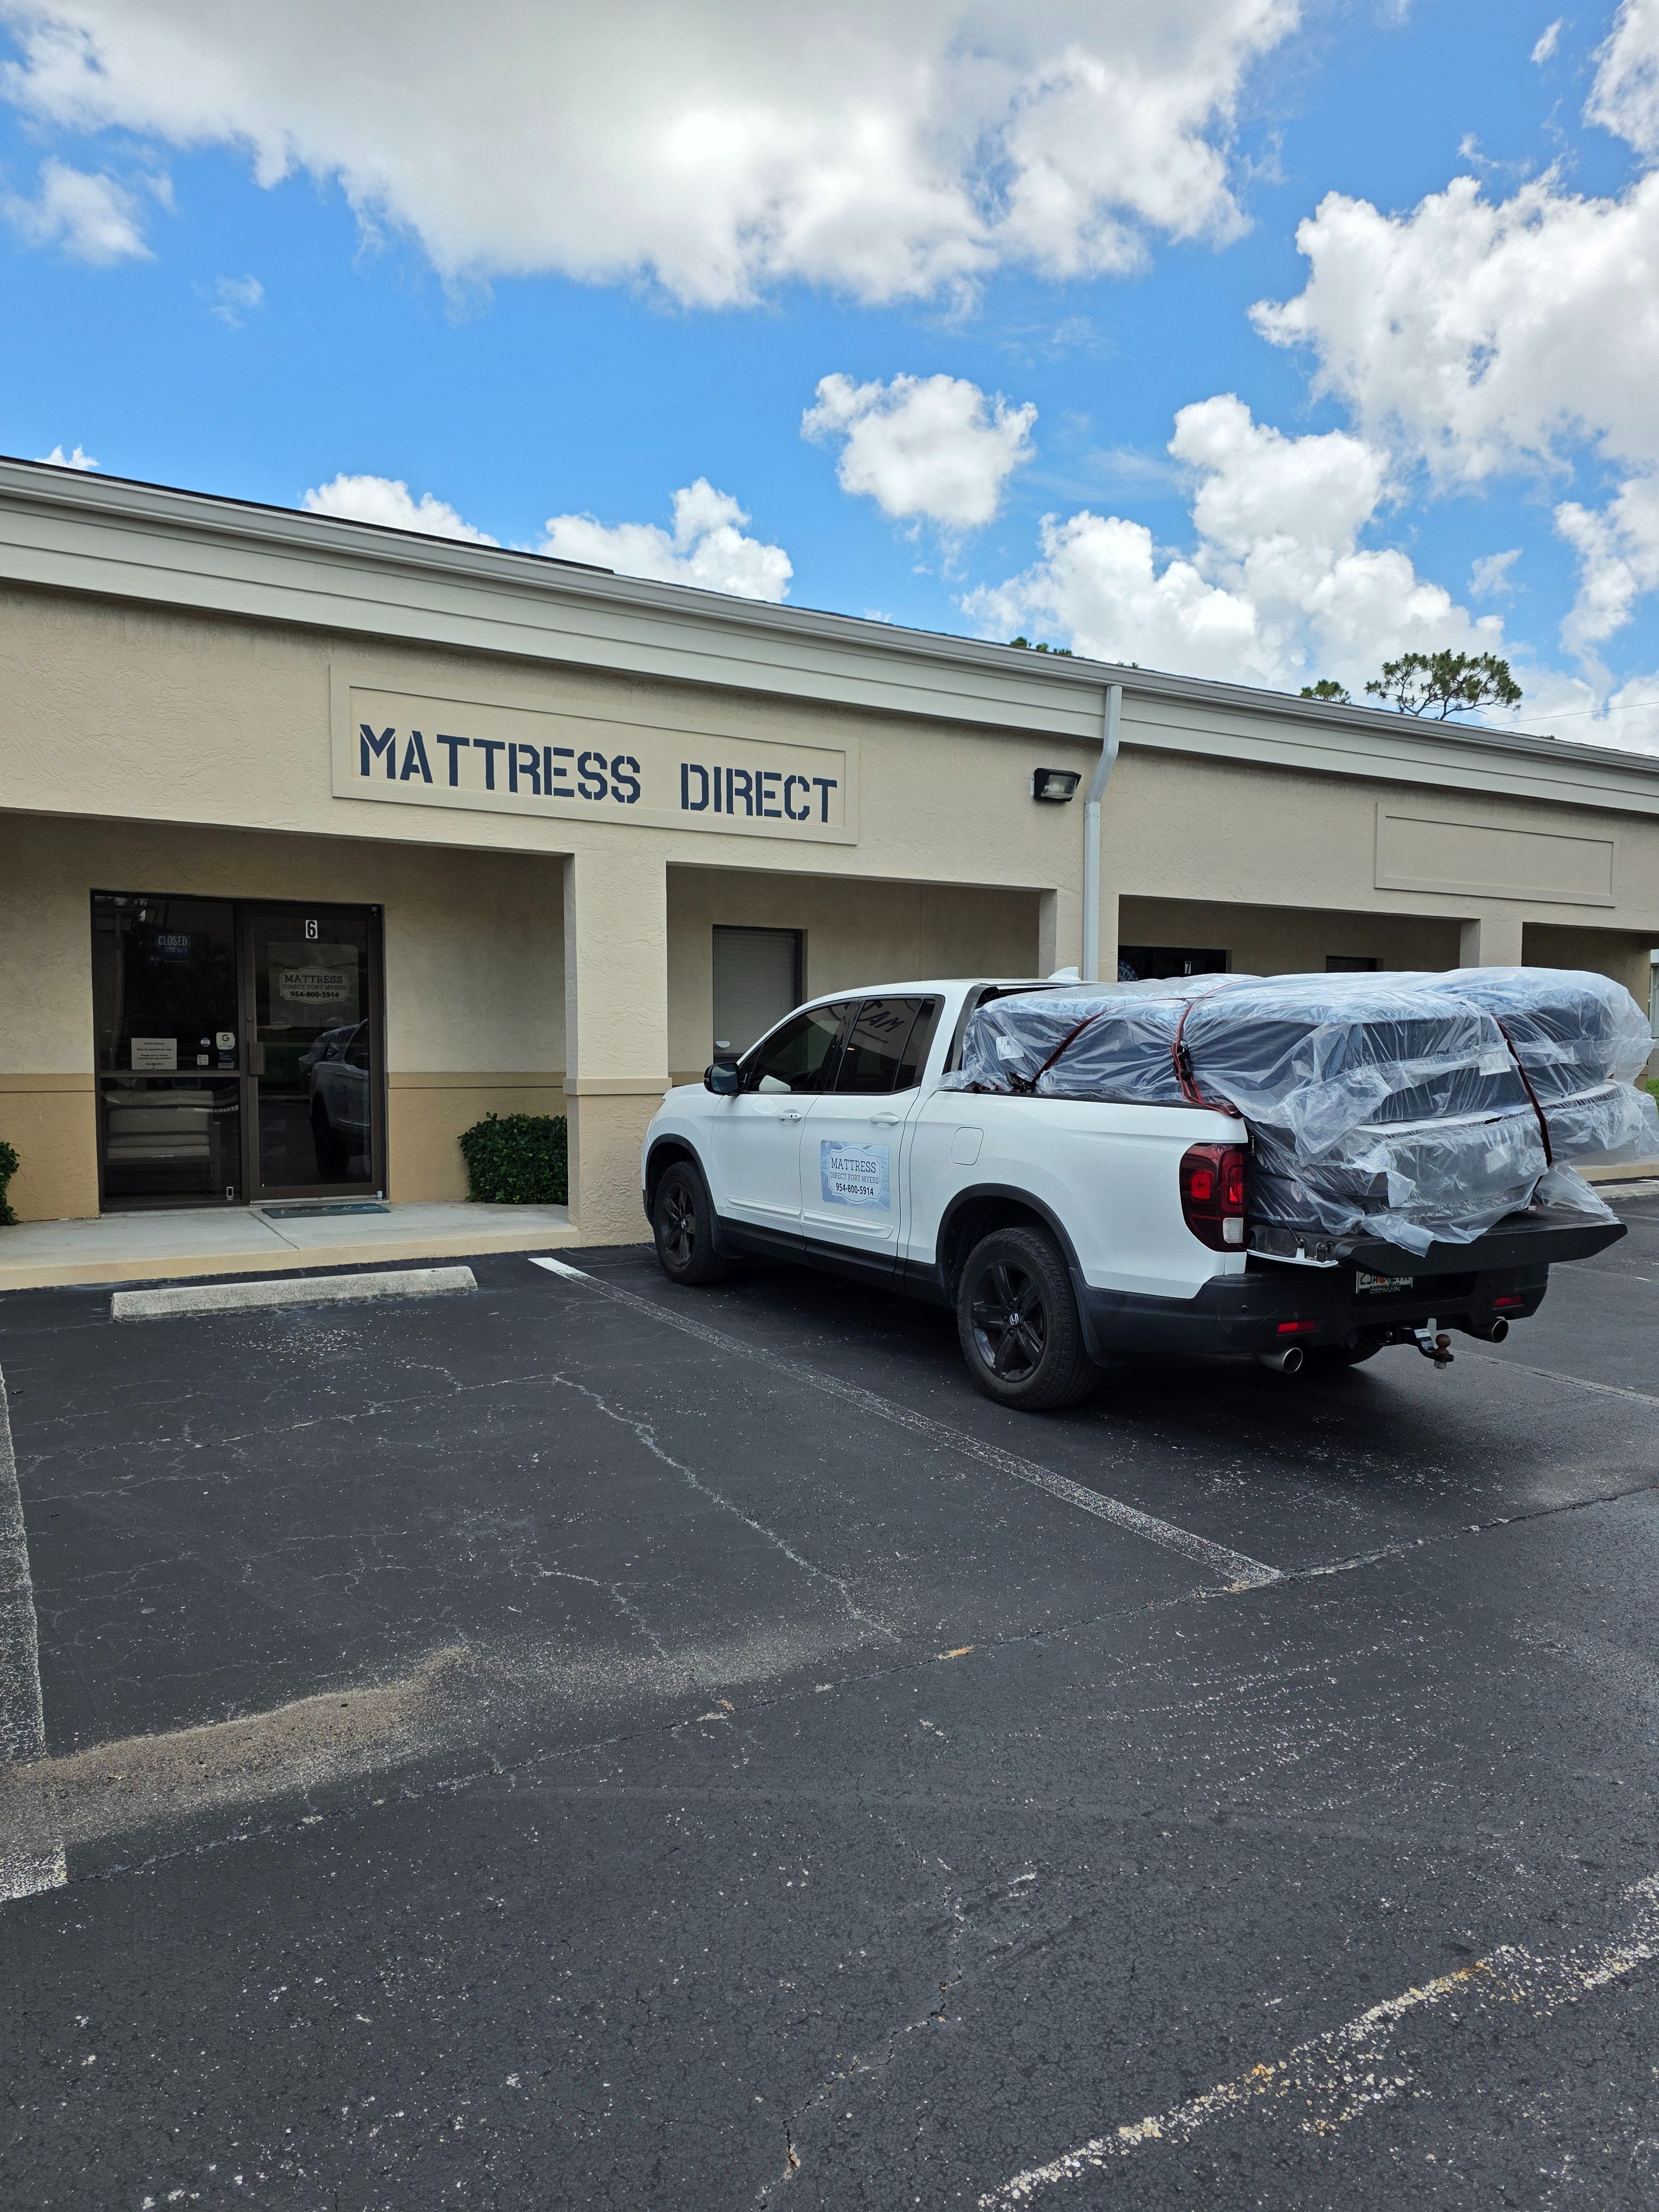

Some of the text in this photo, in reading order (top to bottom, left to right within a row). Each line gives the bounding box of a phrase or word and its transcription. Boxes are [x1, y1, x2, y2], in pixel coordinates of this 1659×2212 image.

[359, 724, 838, 823] MATTRESS DIRECT
[307, 920, 316, 938] 6
[158, 935, 187, 946] CLOSED
[284, 974, 343, 984] MATTRESS
[831, 1157, 877, 1173] MATTRESS
[830, 1171, 879, 1184] DIRECT FORT MYERS
[836, 1182, 874, 1196] 954-800-5914
